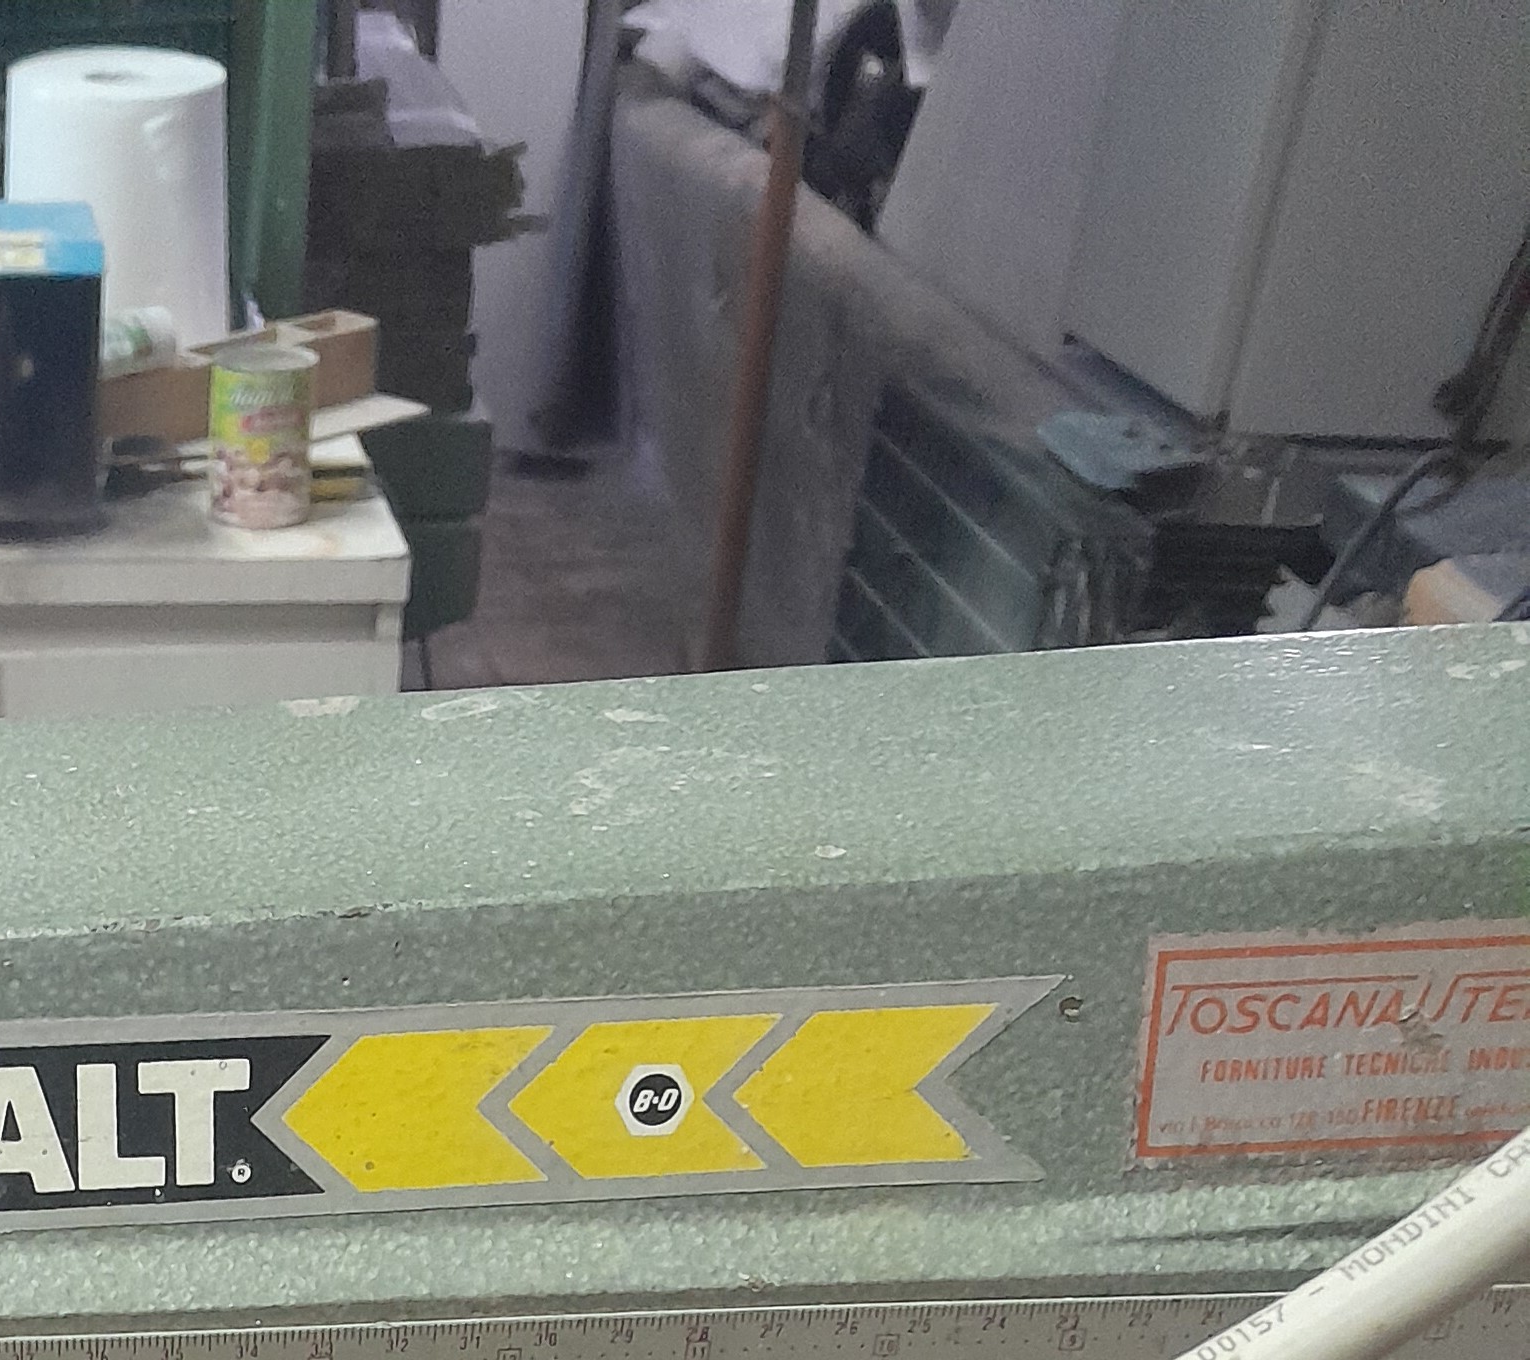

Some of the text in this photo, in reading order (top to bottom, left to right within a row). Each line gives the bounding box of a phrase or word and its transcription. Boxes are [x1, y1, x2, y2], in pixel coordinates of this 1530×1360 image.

[1200, 1054, 1327, 1084] FORNITURE
[1468, 1045, 1530, 1072] INDU
[1341, 1186, 1476, 1281] MONDINI
[387, 1338, 409, 1352] 32
[460, 1336, 481, 1350] 31
[535, 1333, 557, 1347] 30
[610, 1329, 634, 1343] 29
[686, 1327, 709, 1341] 28
[760, 1323, 784, 1338] 27
[835, 1321, 859, 1335] 26
[907, 1319, 931, 1333] 25
[691, 1346, 705, 1358] 11
